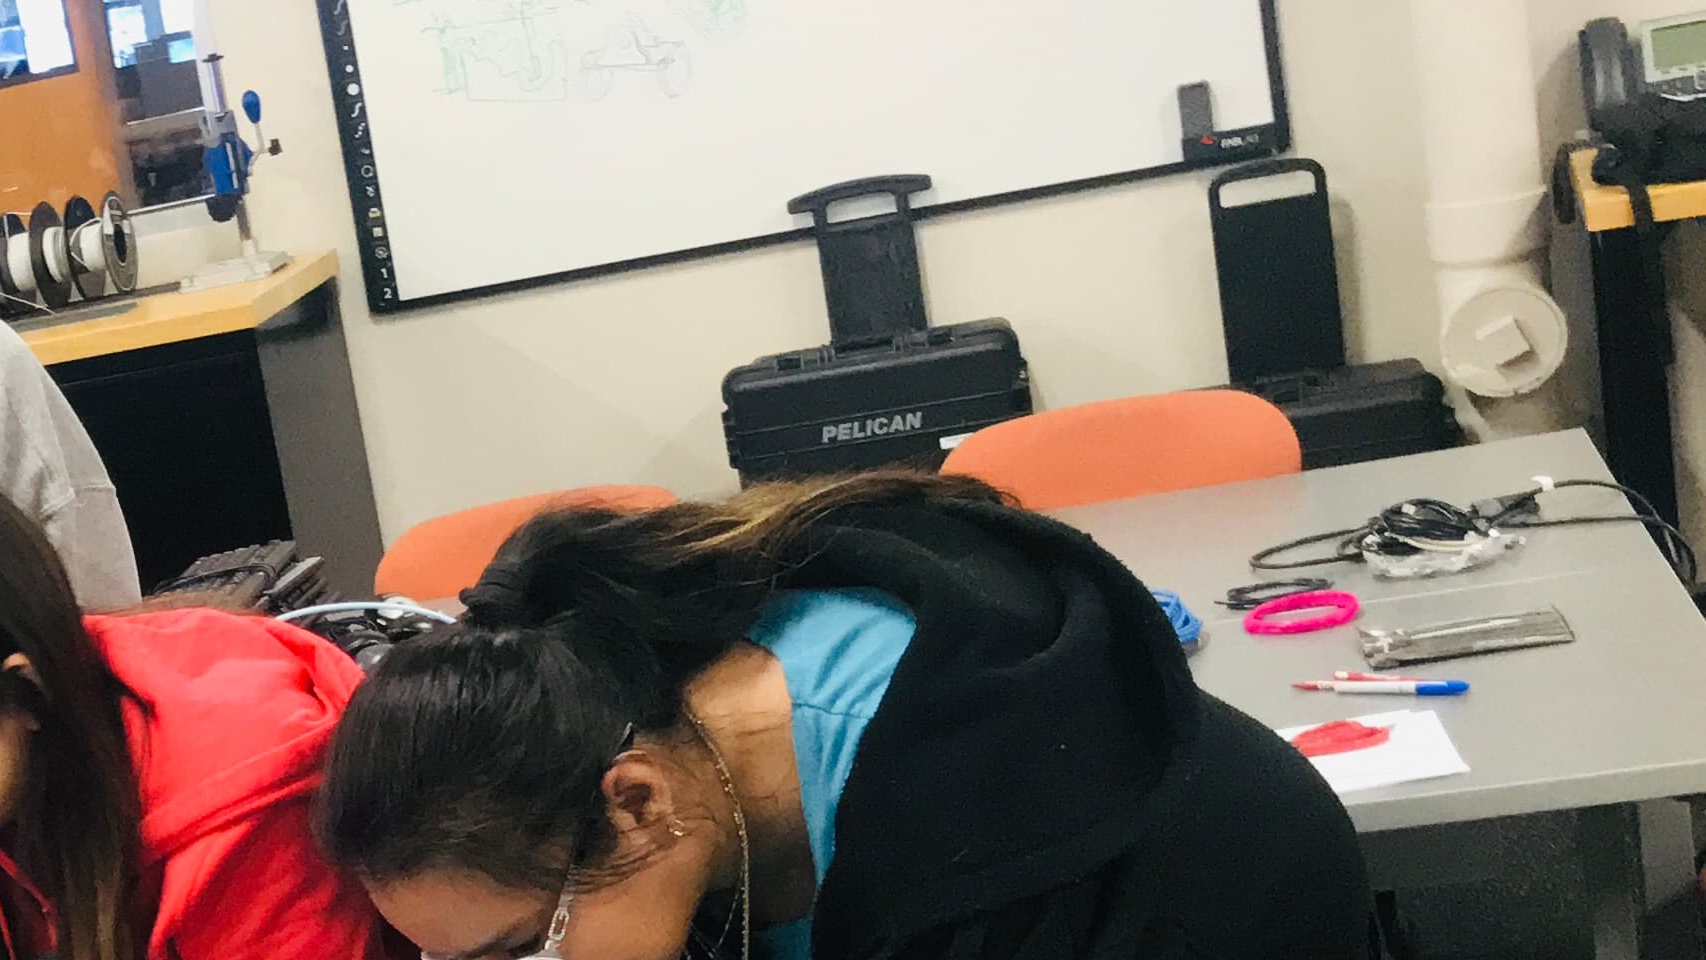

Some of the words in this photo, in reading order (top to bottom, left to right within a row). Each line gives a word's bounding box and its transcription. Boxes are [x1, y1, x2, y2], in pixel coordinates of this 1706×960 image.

[380, 268, 389, 279] 1
[383, 287, 393, 299] 2
[821, 411, 923, 443] PELICAN
